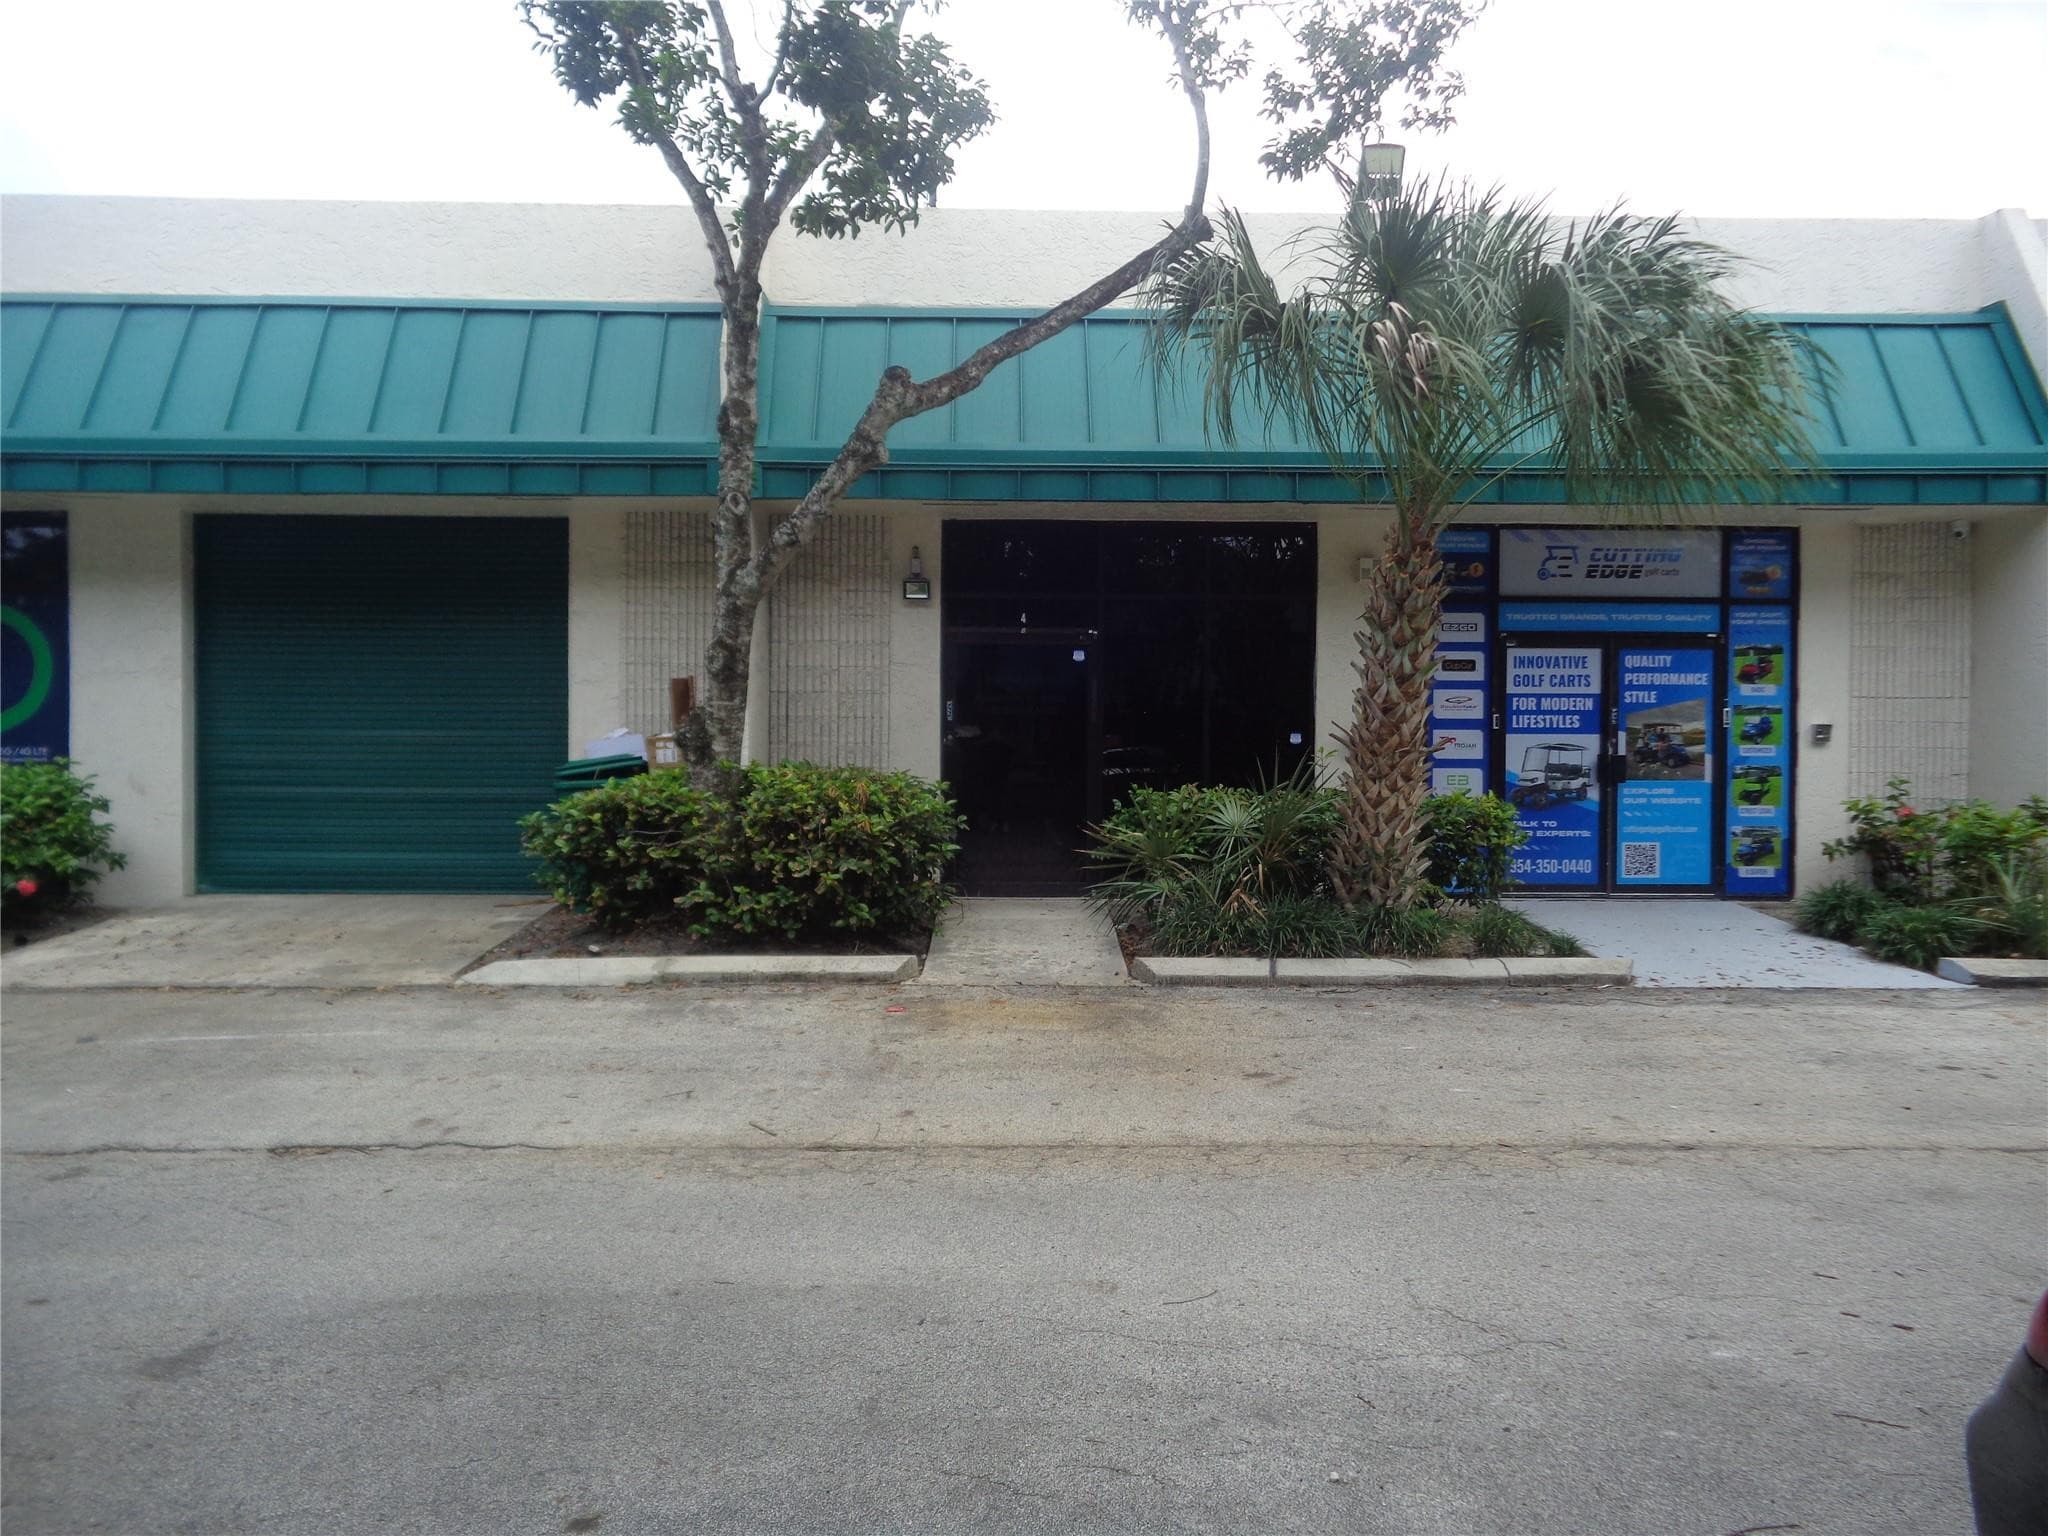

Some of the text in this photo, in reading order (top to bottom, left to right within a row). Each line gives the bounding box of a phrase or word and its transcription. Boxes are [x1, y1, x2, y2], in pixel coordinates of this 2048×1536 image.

[1588, 547, 1685, 563] CUTTING
[1585, 564, 1680, 579] EDGE golf carts
[1020, 612, 1026, 624] 4
[1505, 613, 1556, 622] TRUSTED
[1611, 613, 1661, 622] TRUSTED
[1664, 613, 1712, 622] QUALITY
[1442, 623, 1477, 631] EZGO
[1513, 655, 1589, 669] INNOVATIVE
[1624, 655, 1672, 669] QUALITY
[1512, 674, 1592, 688] GOLF CARTS
[1624, 673, 1709, 686] PERFORMANCE
[1512, 697, 1594, 711] FOR MODERN
[1624, 691, 1657, 704] STYLE
[1511, 715, 1580, 729] LIFESTYLES
